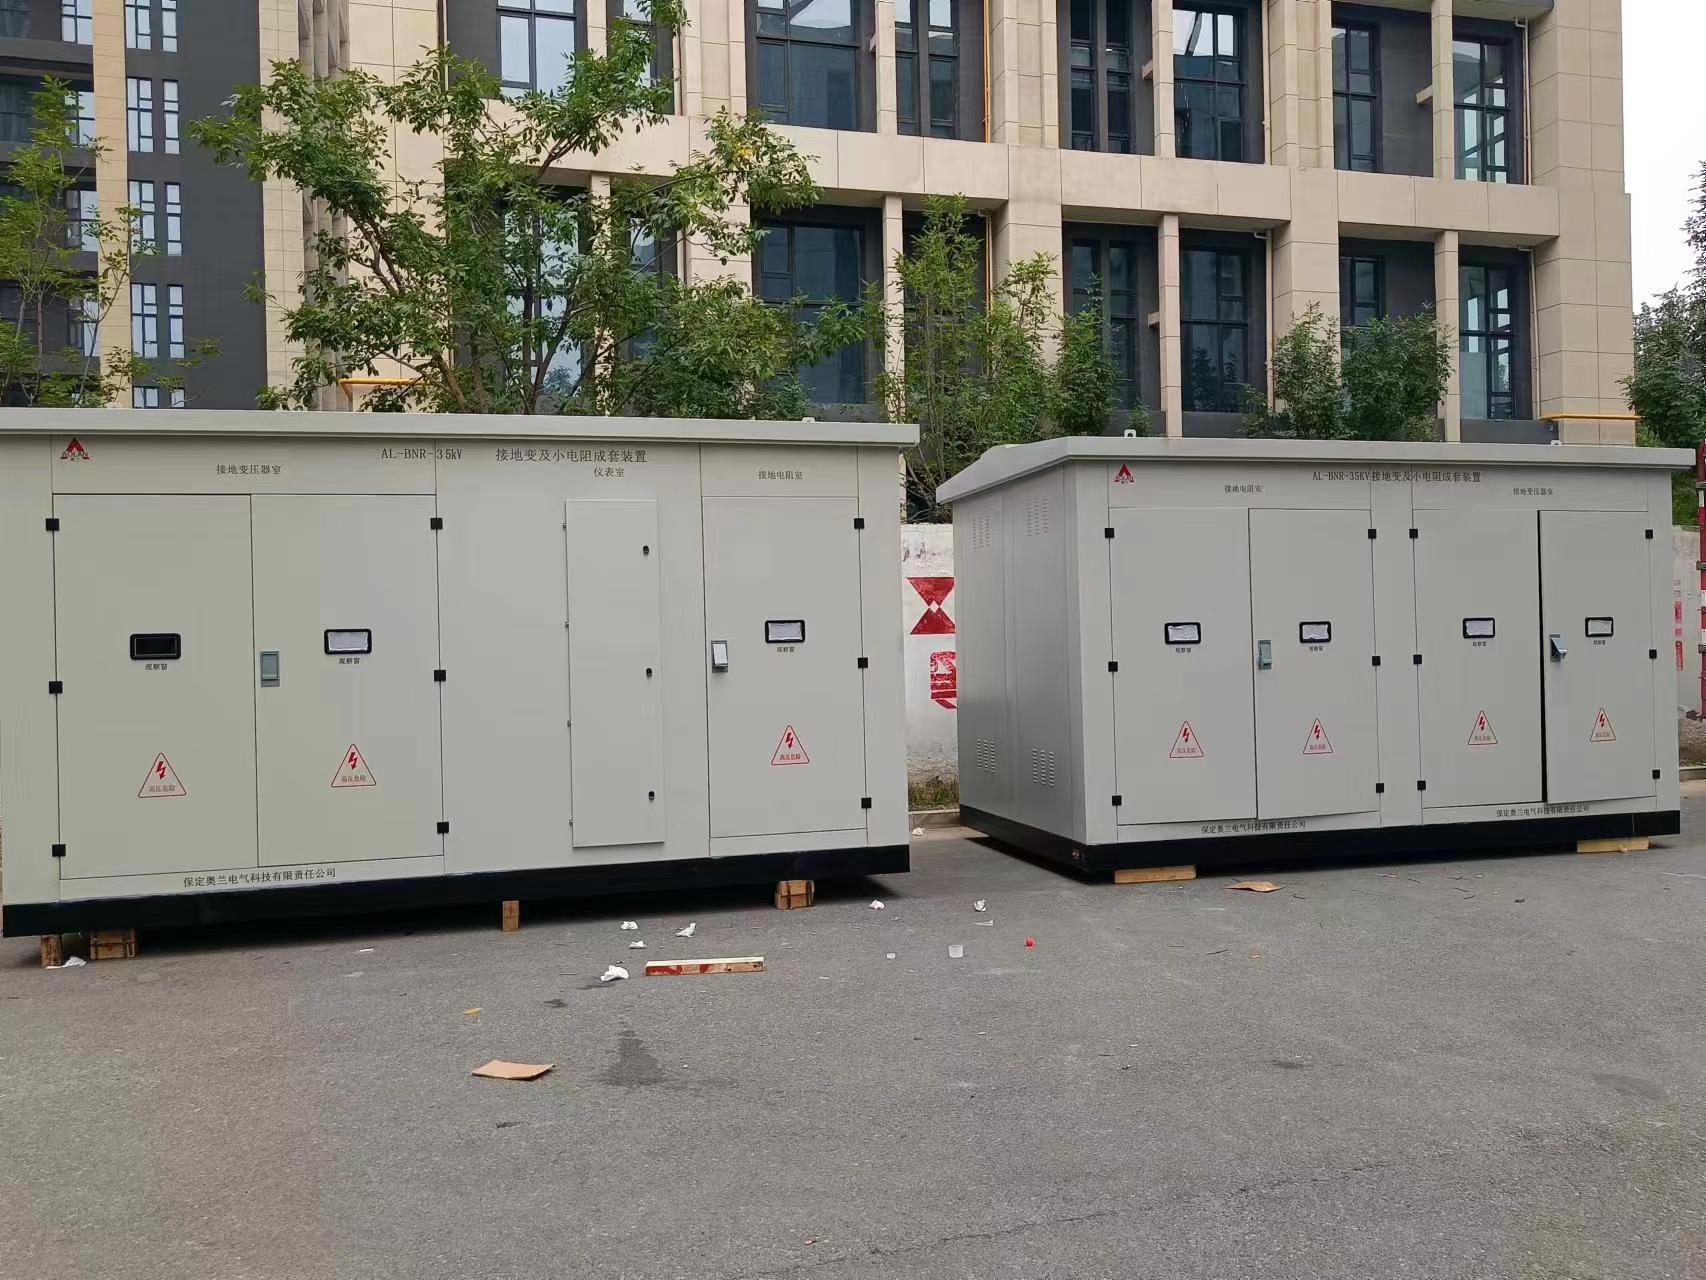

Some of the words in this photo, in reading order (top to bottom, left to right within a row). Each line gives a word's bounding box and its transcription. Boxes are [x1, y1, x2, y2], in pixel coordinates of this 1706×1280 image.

[495, 447, 647, 463] 接地变及小电阻成套装置
[216, 464, 282, 475] 接地变压器室
[593, 466, 625, 478] 仪表室
[757, 469, 804, 480] 接地电阻室
[338, 657, 361, 665] 观察窗
[183, 867, 337, 887] 保定奥兰电气科技有限责任公司
